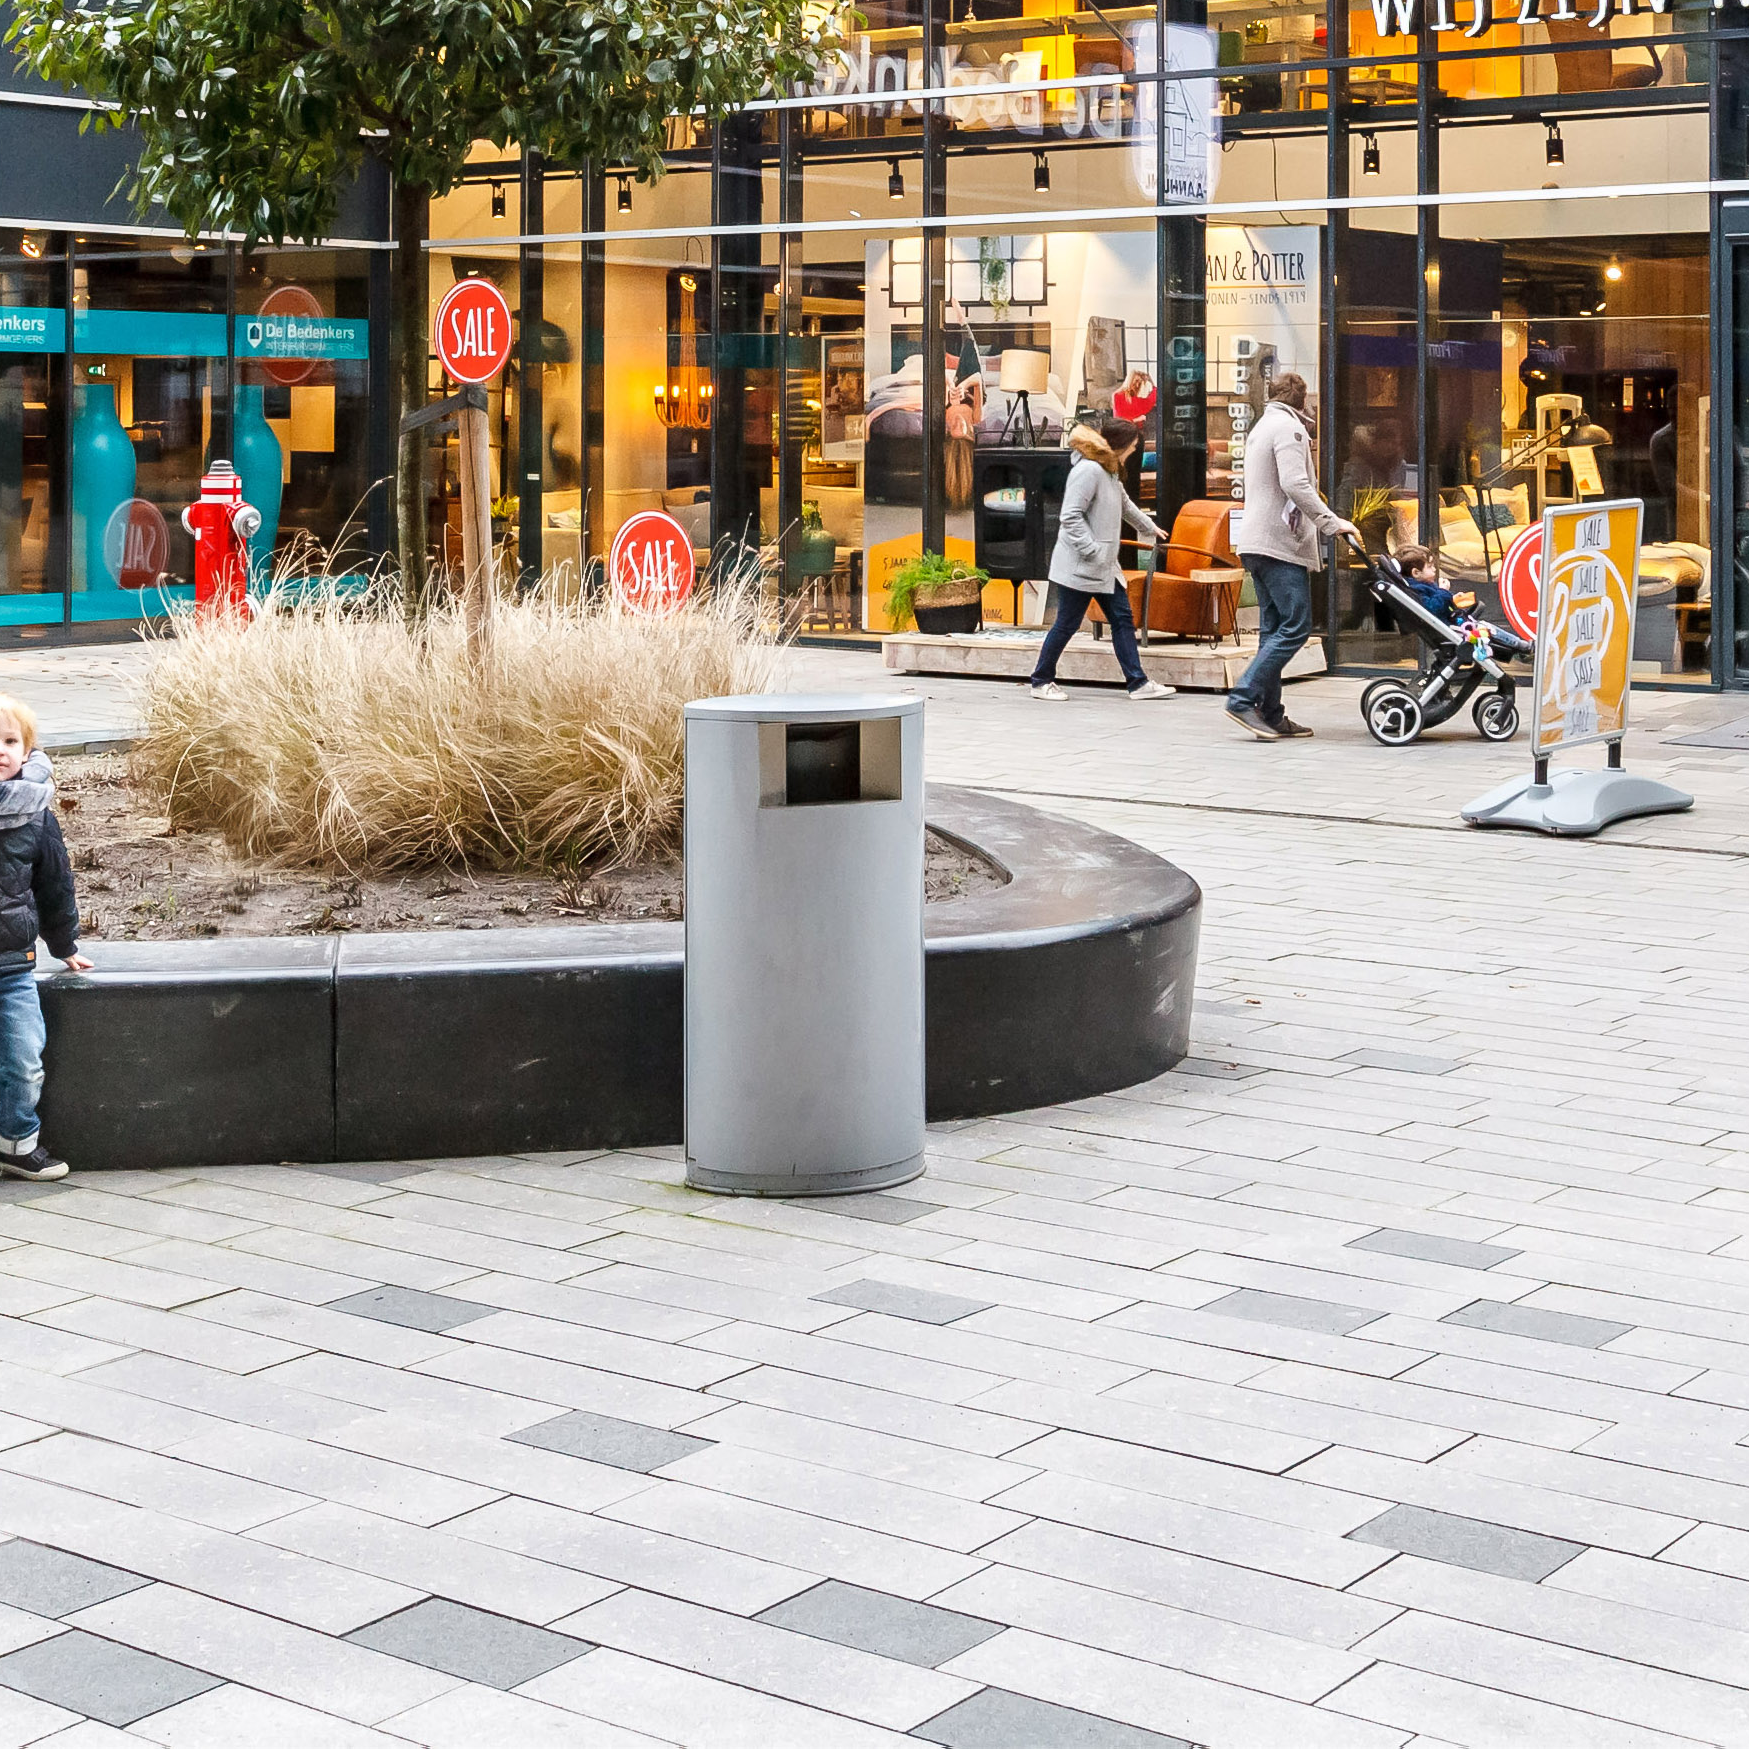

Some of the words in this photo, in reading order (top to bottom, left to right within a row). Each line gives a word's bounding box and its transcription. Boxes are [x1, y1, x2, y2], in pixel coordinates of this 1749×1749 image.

[1232, 250, 1247, 281] &
[1252, 249, 1305, 282] POTTER
[265, 323, 283, 338] De
[287, 323, 355, 340] Bedenkers
[450, 306, 498, 360] SALE
[1581, 518, 1603, 549] SALE
[627, 539, 679, 595] SALE
[1576, 559, 1599, 596] SALE
[1574, 612, 1596, 643] SALE
[1572, 656, 1594, 688] SALE
